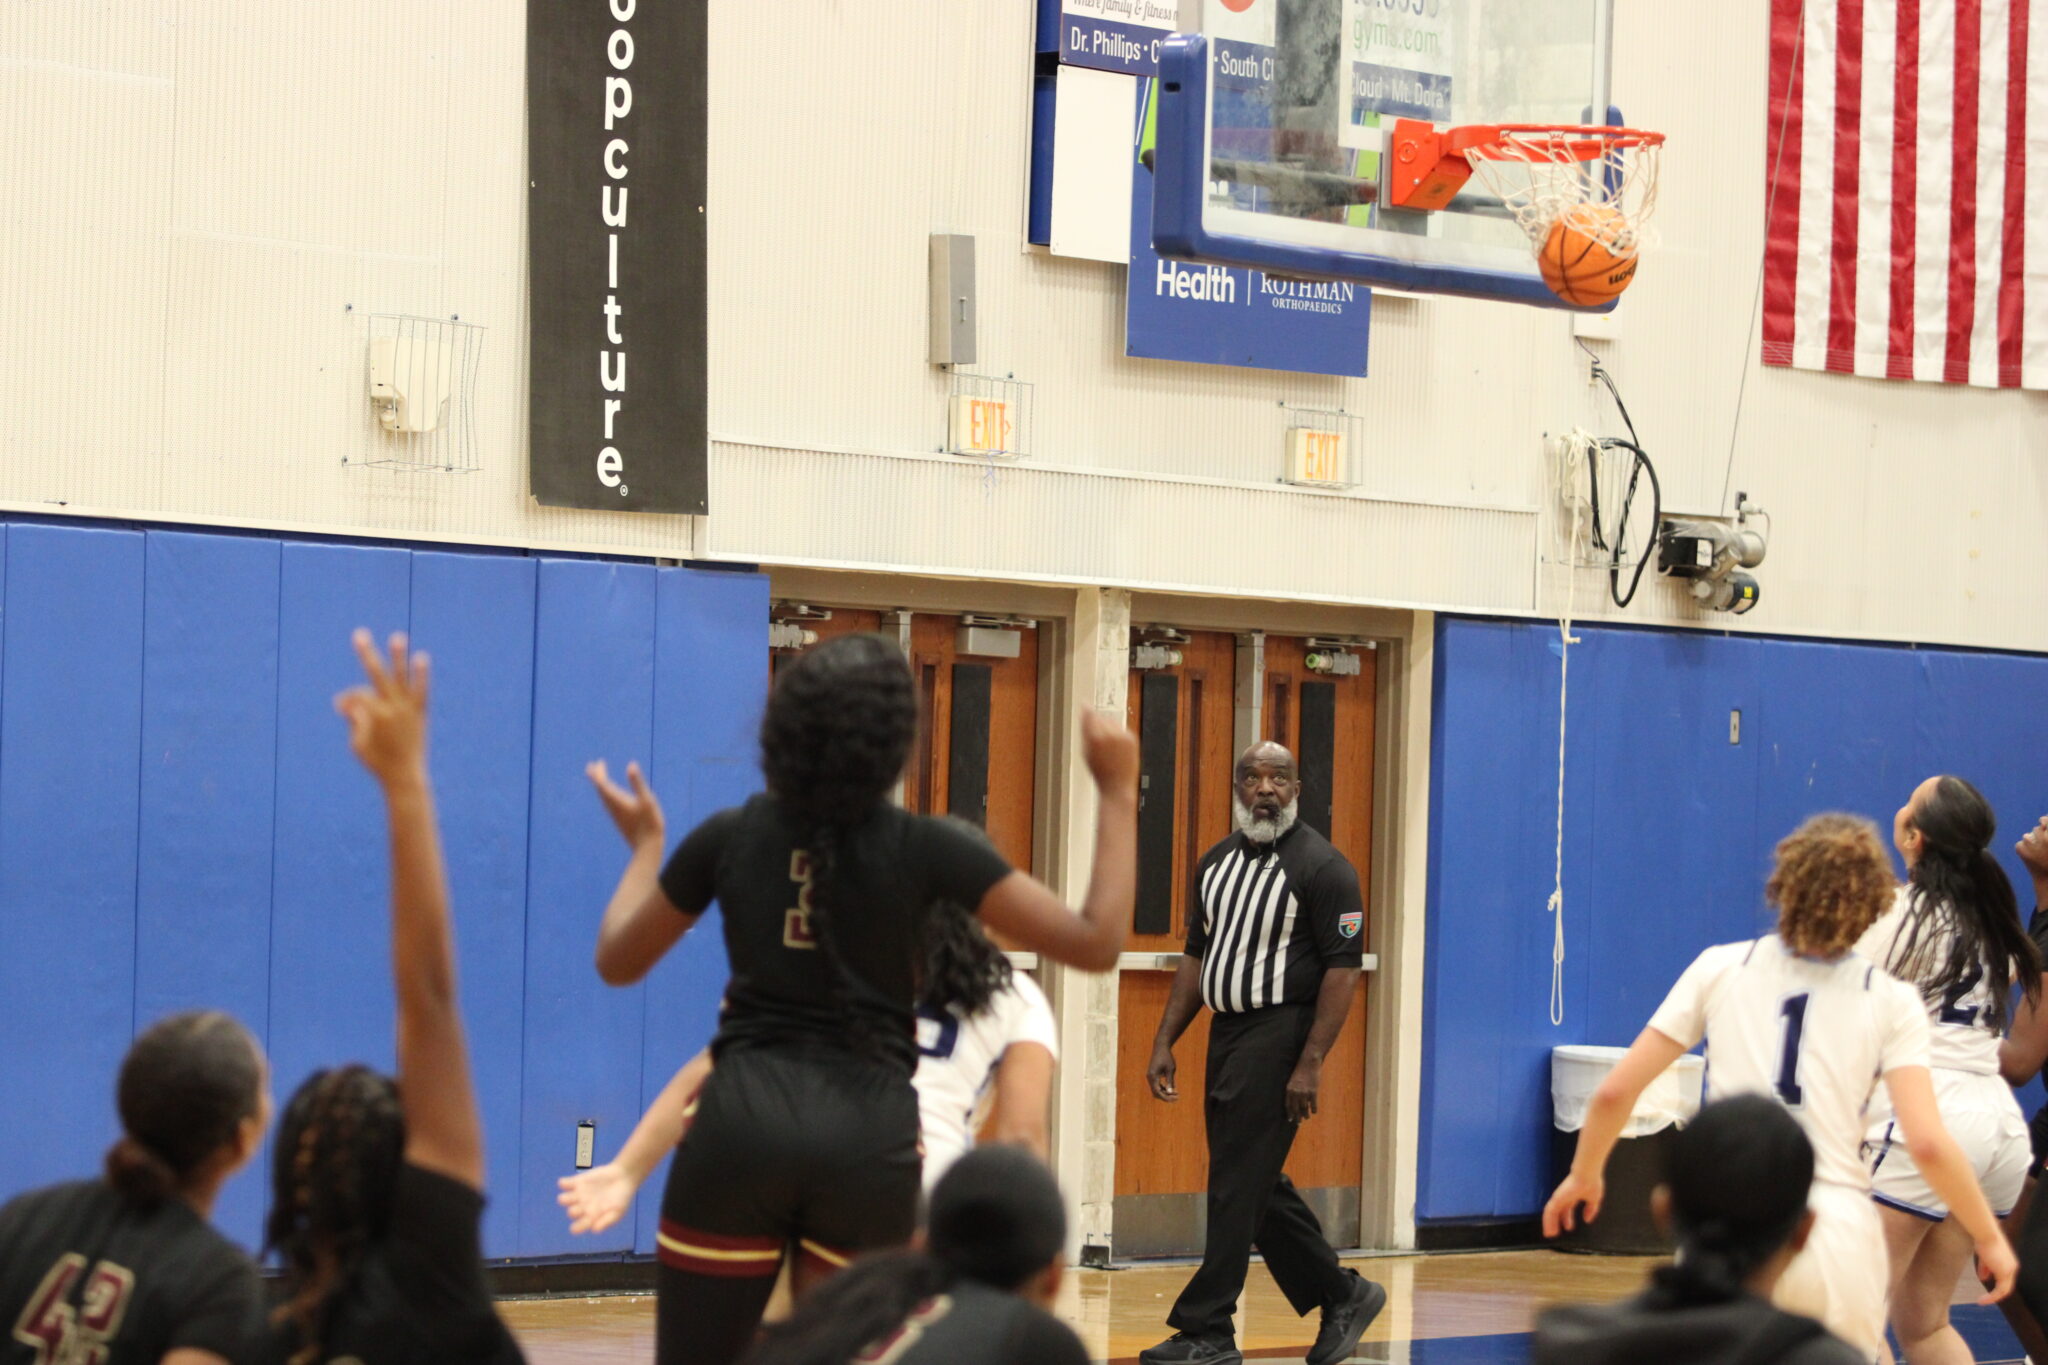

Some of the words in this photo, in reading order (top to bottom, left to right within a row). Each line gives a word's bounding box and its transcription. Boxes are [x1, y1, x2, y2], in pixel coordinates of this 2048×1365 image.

[1101, 0, 1131, 18] family
[1135, 1, 1142, 15] &
[1142, 1, 1171, 21] fitness
[1071, 26, 1089, 52] Dr.
[1093, 30, 1141, 64] Phillips
[1221, 50, 1258, 79] South
[1414, 82, 1444, 108] Dora
[1156, 259, 1235, 303] Health
[1260, 272, 1354, 302] ROTHMAN
[1272, 297, 1342, 314] ORTHOPAEDICS
[970, 399, 1006, 450] EXIT
[1305, 431, 1341, 481] EXIT
[1773, 990, 1811, 1108] 1
